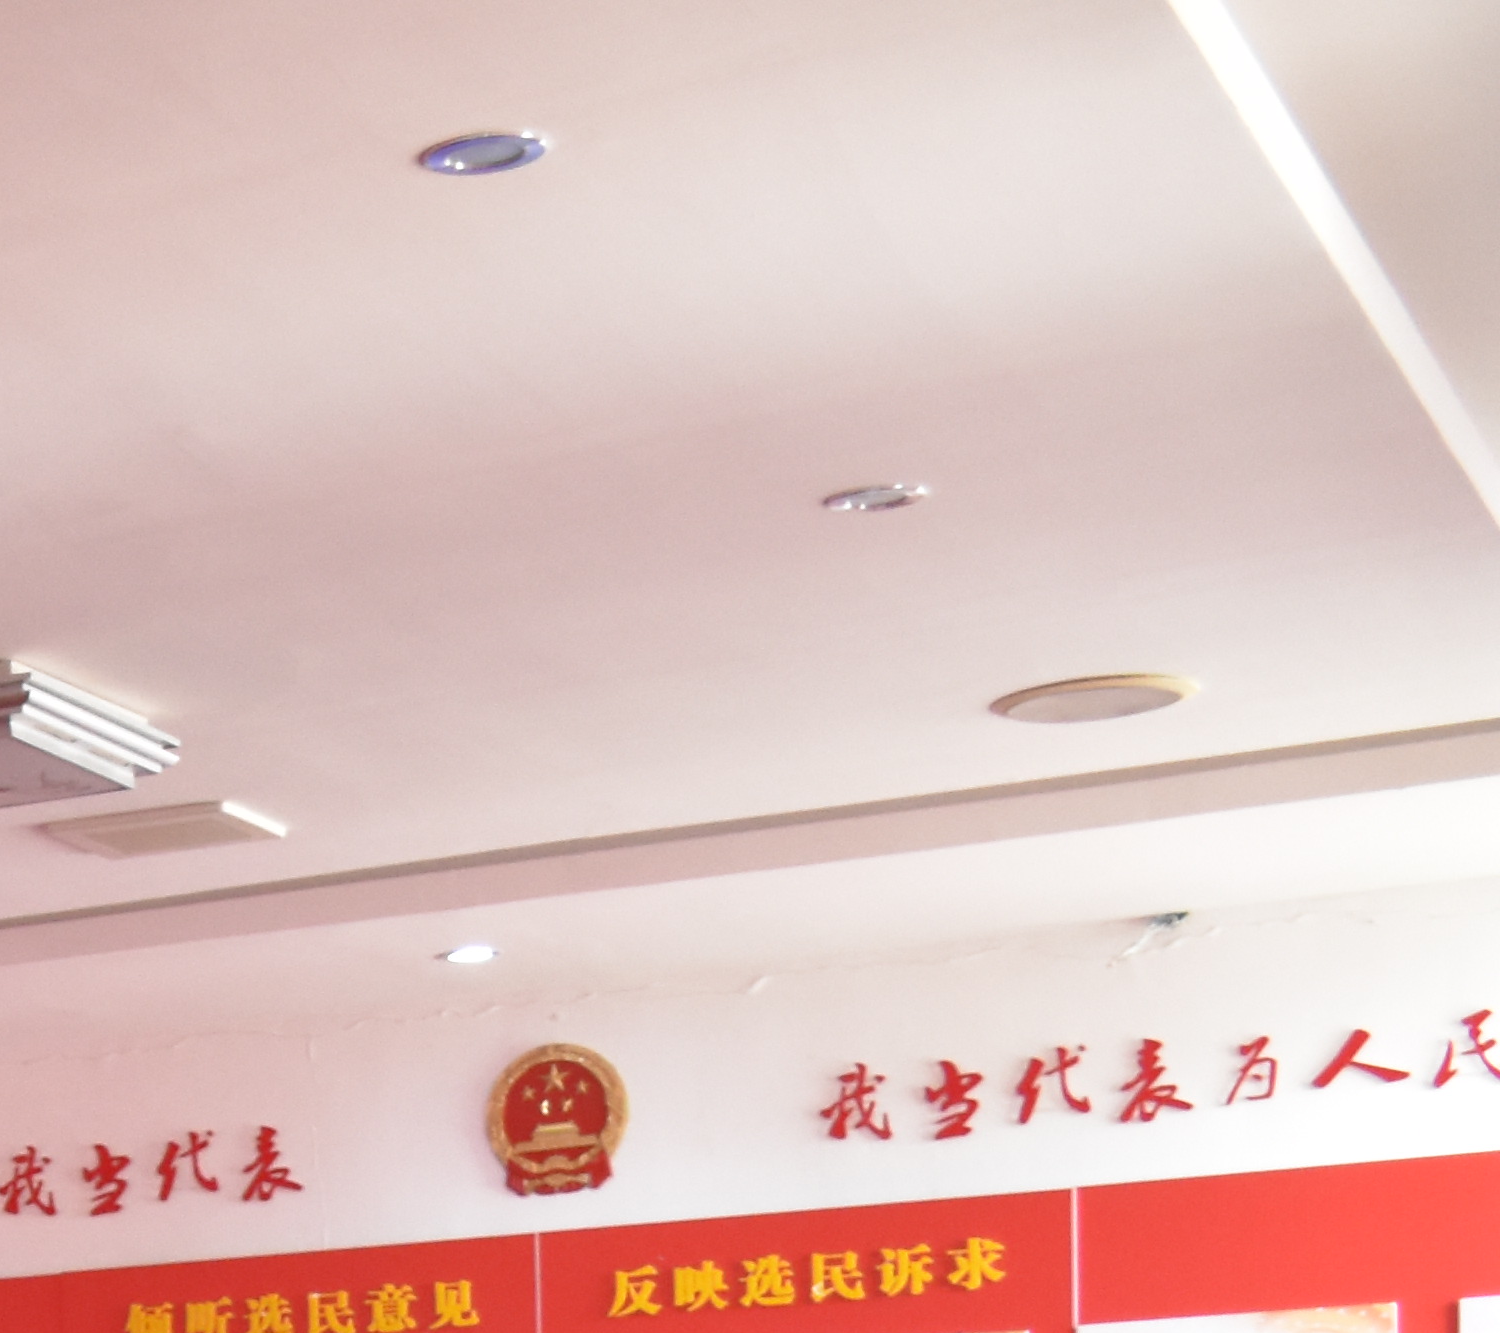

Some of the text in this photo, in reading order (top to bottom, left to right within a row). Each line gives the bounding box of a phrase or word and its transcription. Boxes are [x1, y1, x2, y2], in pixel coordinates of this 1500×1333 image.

[820, 1009, 1500, 1140] 我当代表为人民
[607, 1236, 1007, 1317] 反映选民诉求
